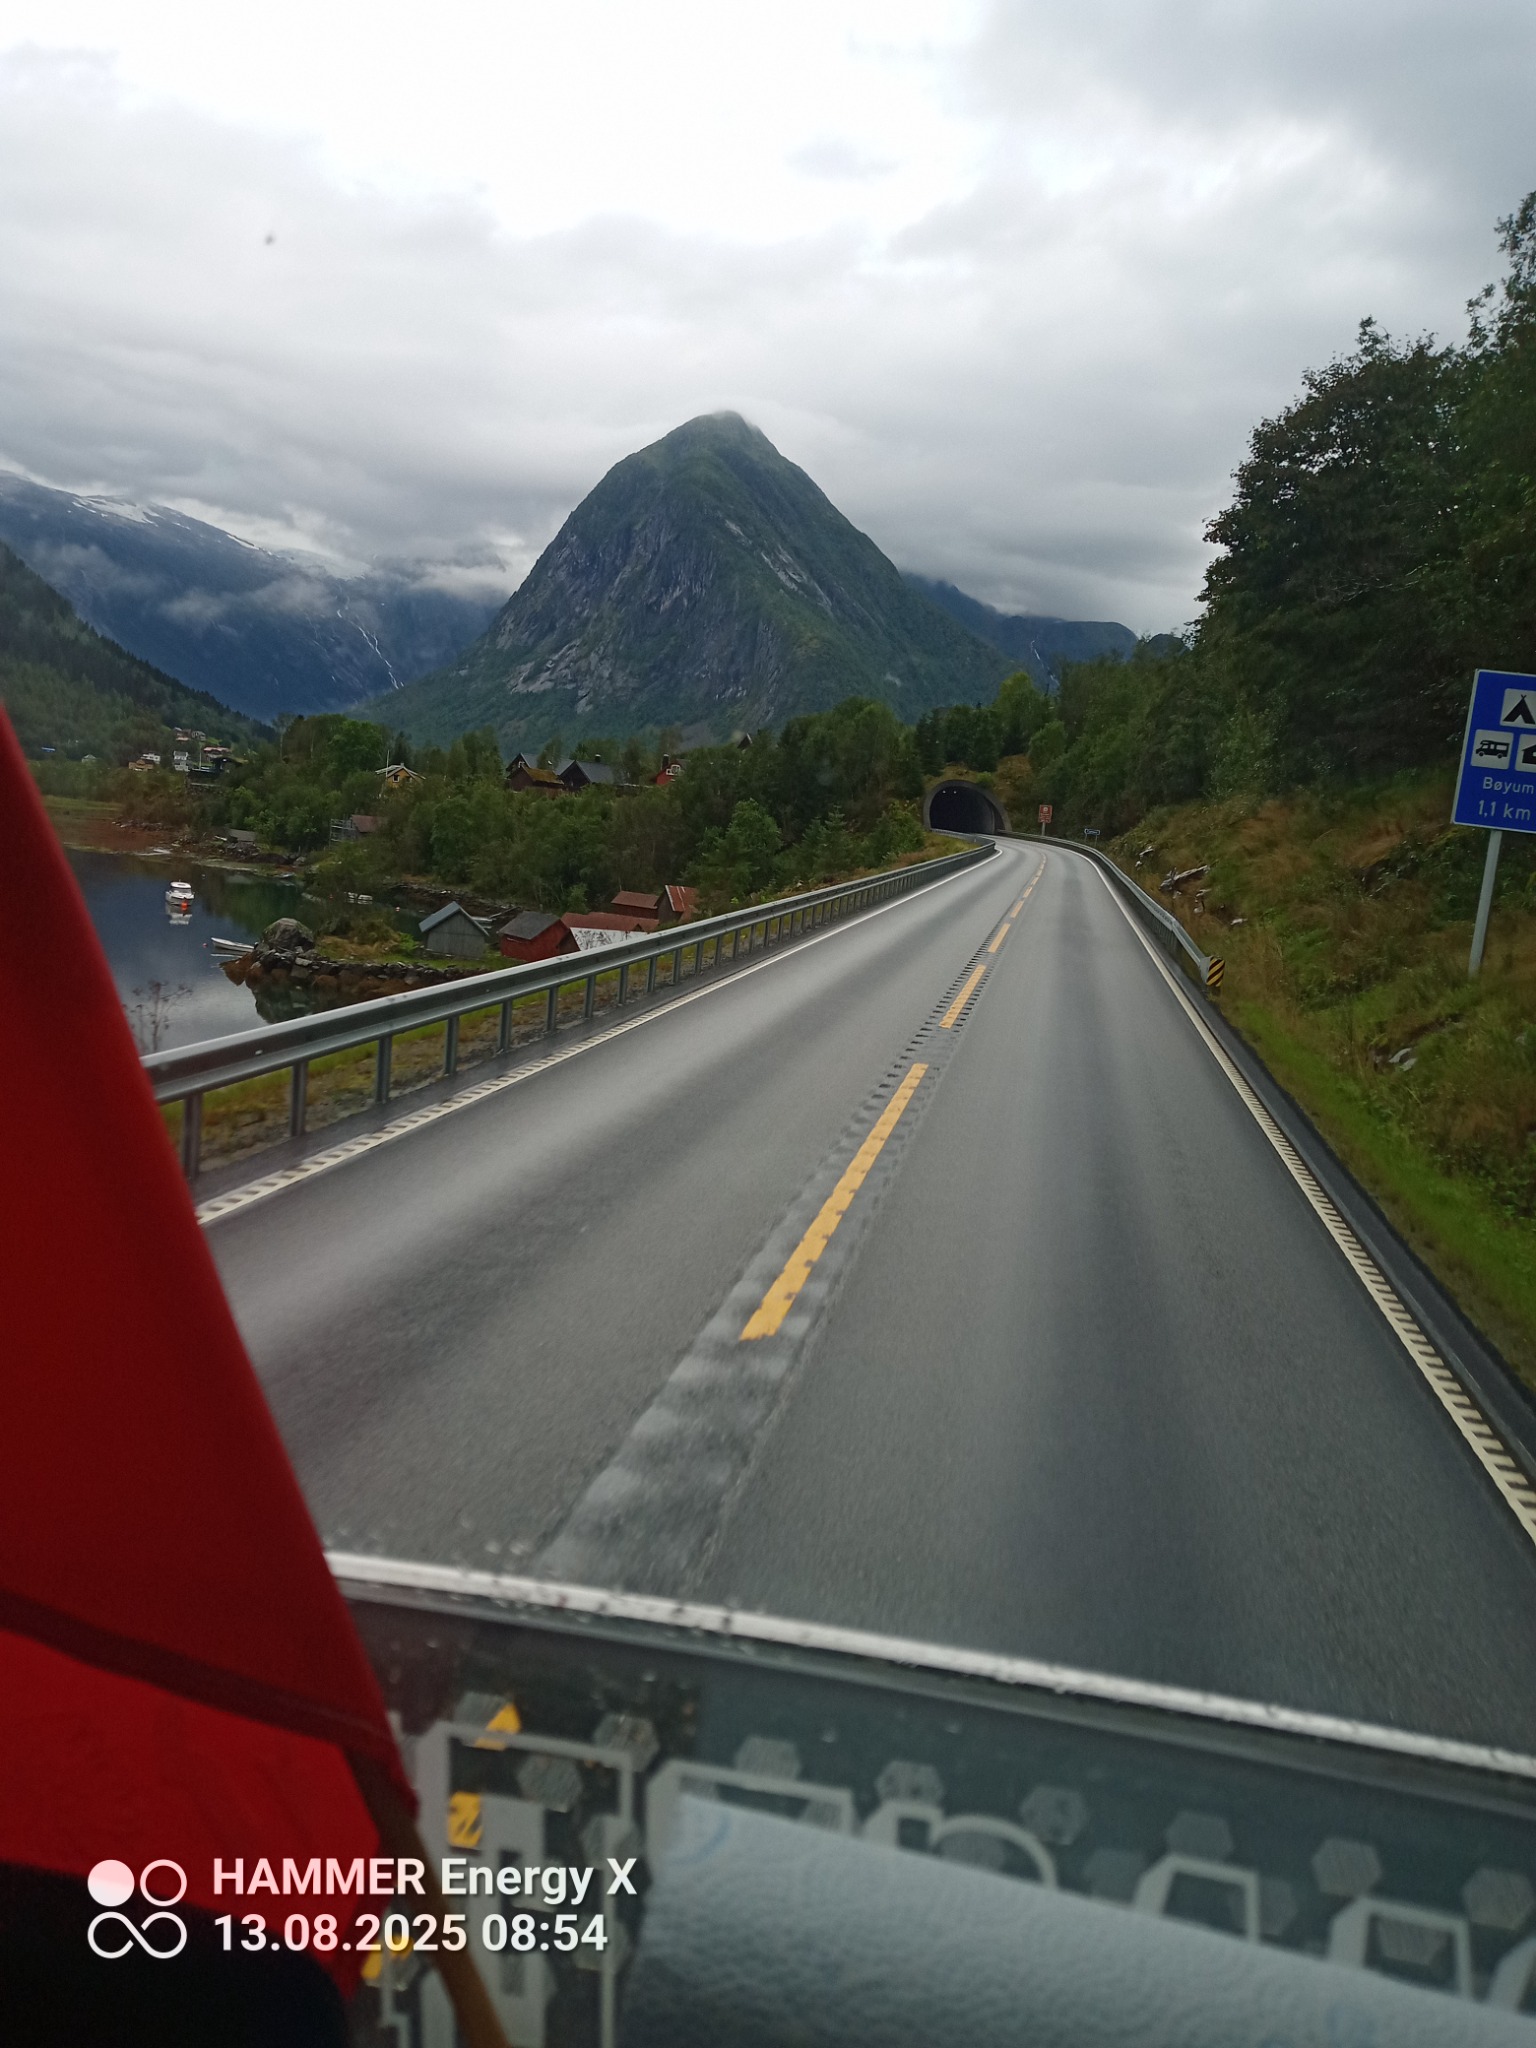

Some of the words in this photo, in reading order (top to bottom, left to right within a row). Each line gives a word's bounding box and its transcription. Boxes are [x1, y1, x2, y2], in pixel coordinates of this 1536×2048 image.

[1482, 776, 1534, 795] Bøyum
[1478, 800, 1496, 818] 1,1
[1503, 803, 1531, 821] km
